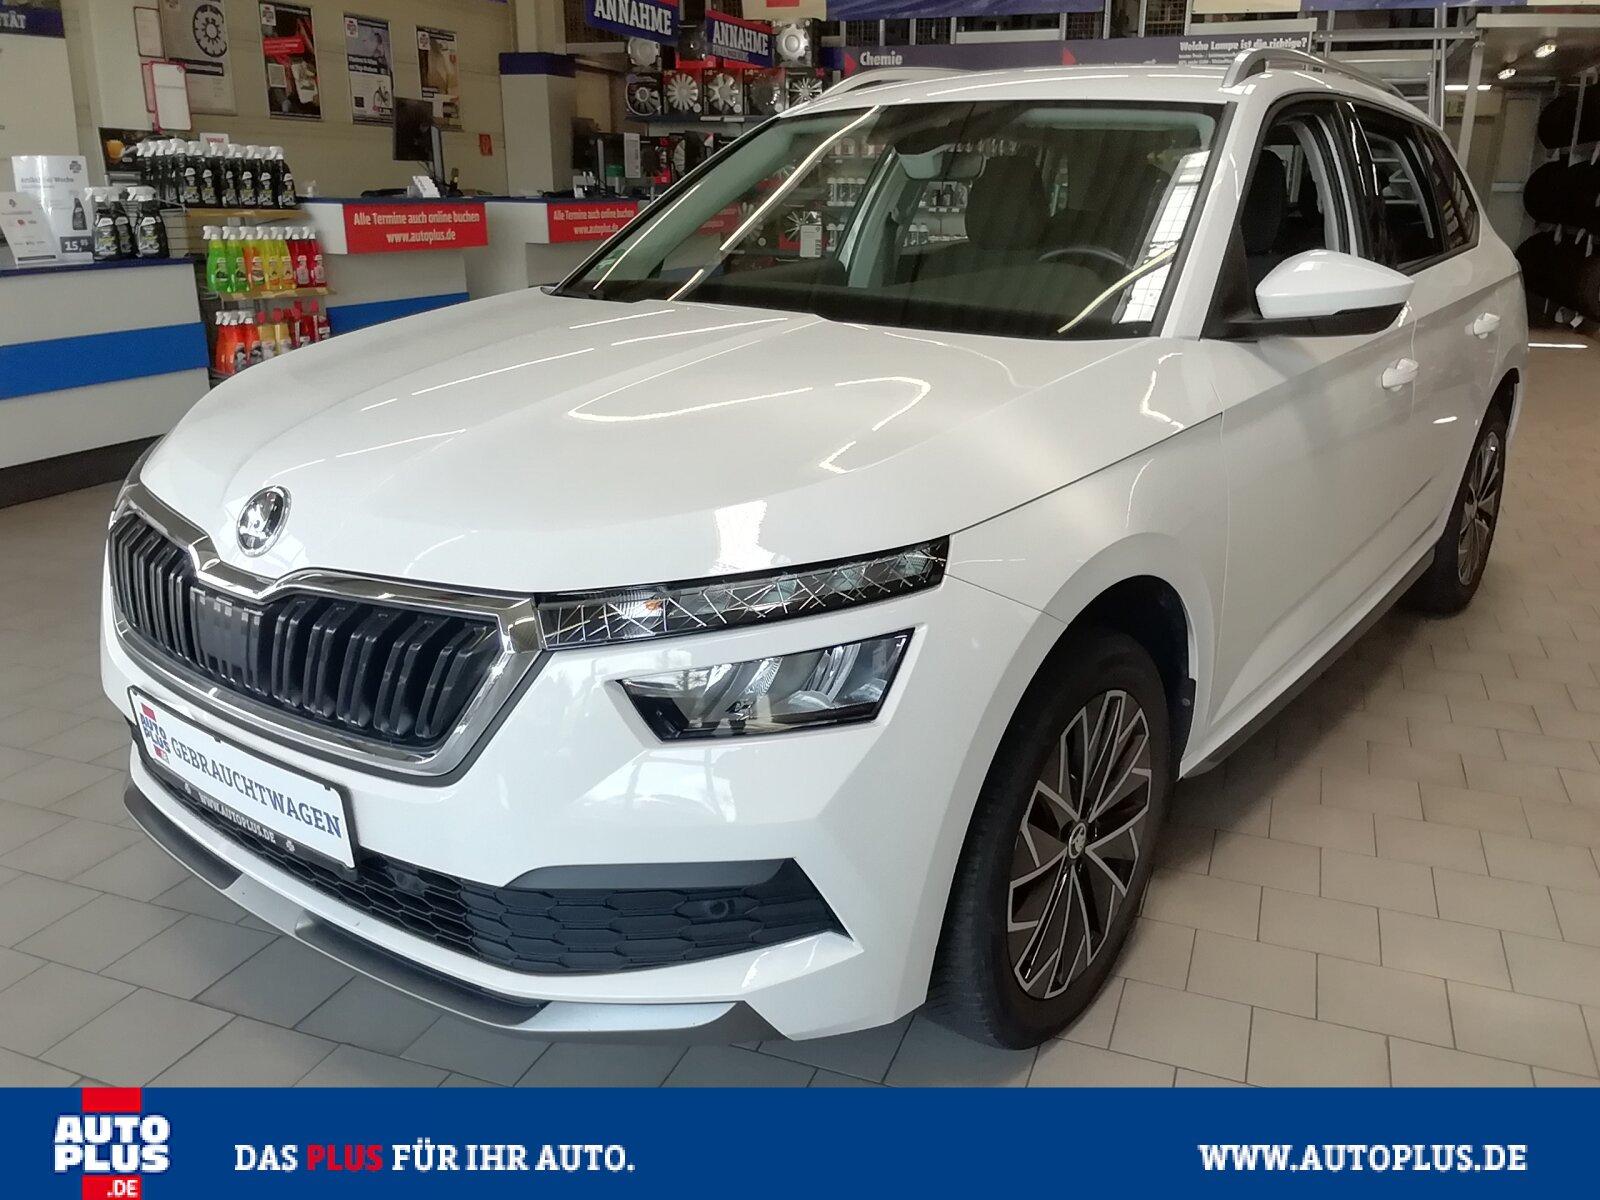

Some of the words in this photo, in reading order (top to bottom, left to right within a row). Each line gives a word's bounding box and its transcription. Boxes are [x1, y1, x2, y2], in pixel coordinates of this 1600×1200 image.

[594, 0, 672, 36] ANNAHME
[713, 20, 769, 56] ANNAHME
[1179, 41, 1209, 51] Welche
[1210, 41, 1239, 51] Lampe
[1240, 38, 1253, 49] ist
[1253, 38, 1268, 48] die
[860, 50, 903, 66] Chemie
[353, 212, 371, 226] Alle
[372, 211, 407, 225] Termine
[408, 211, 427, 224] auch
[428, 211, 453, 223] online
[453, 211, 480, 222] buchen
[553, 209, 565, 220] Alle
[565, 209, 588, 220] Termine
[588, 208, 600, 219] auch
[601, 208, 616, 218] online
[617, 207, 635, 218] buchen
[386, 228, 456, 244] www.autoplus.de
[139, 712, 167, 741] AUTO
[143, 725, 171, 754] PLUS
[171, 736, 342, 839] GEBRAUCHTWAGEN
[199, 791, 276, 844] WWW.AUTOPLUS.DE
